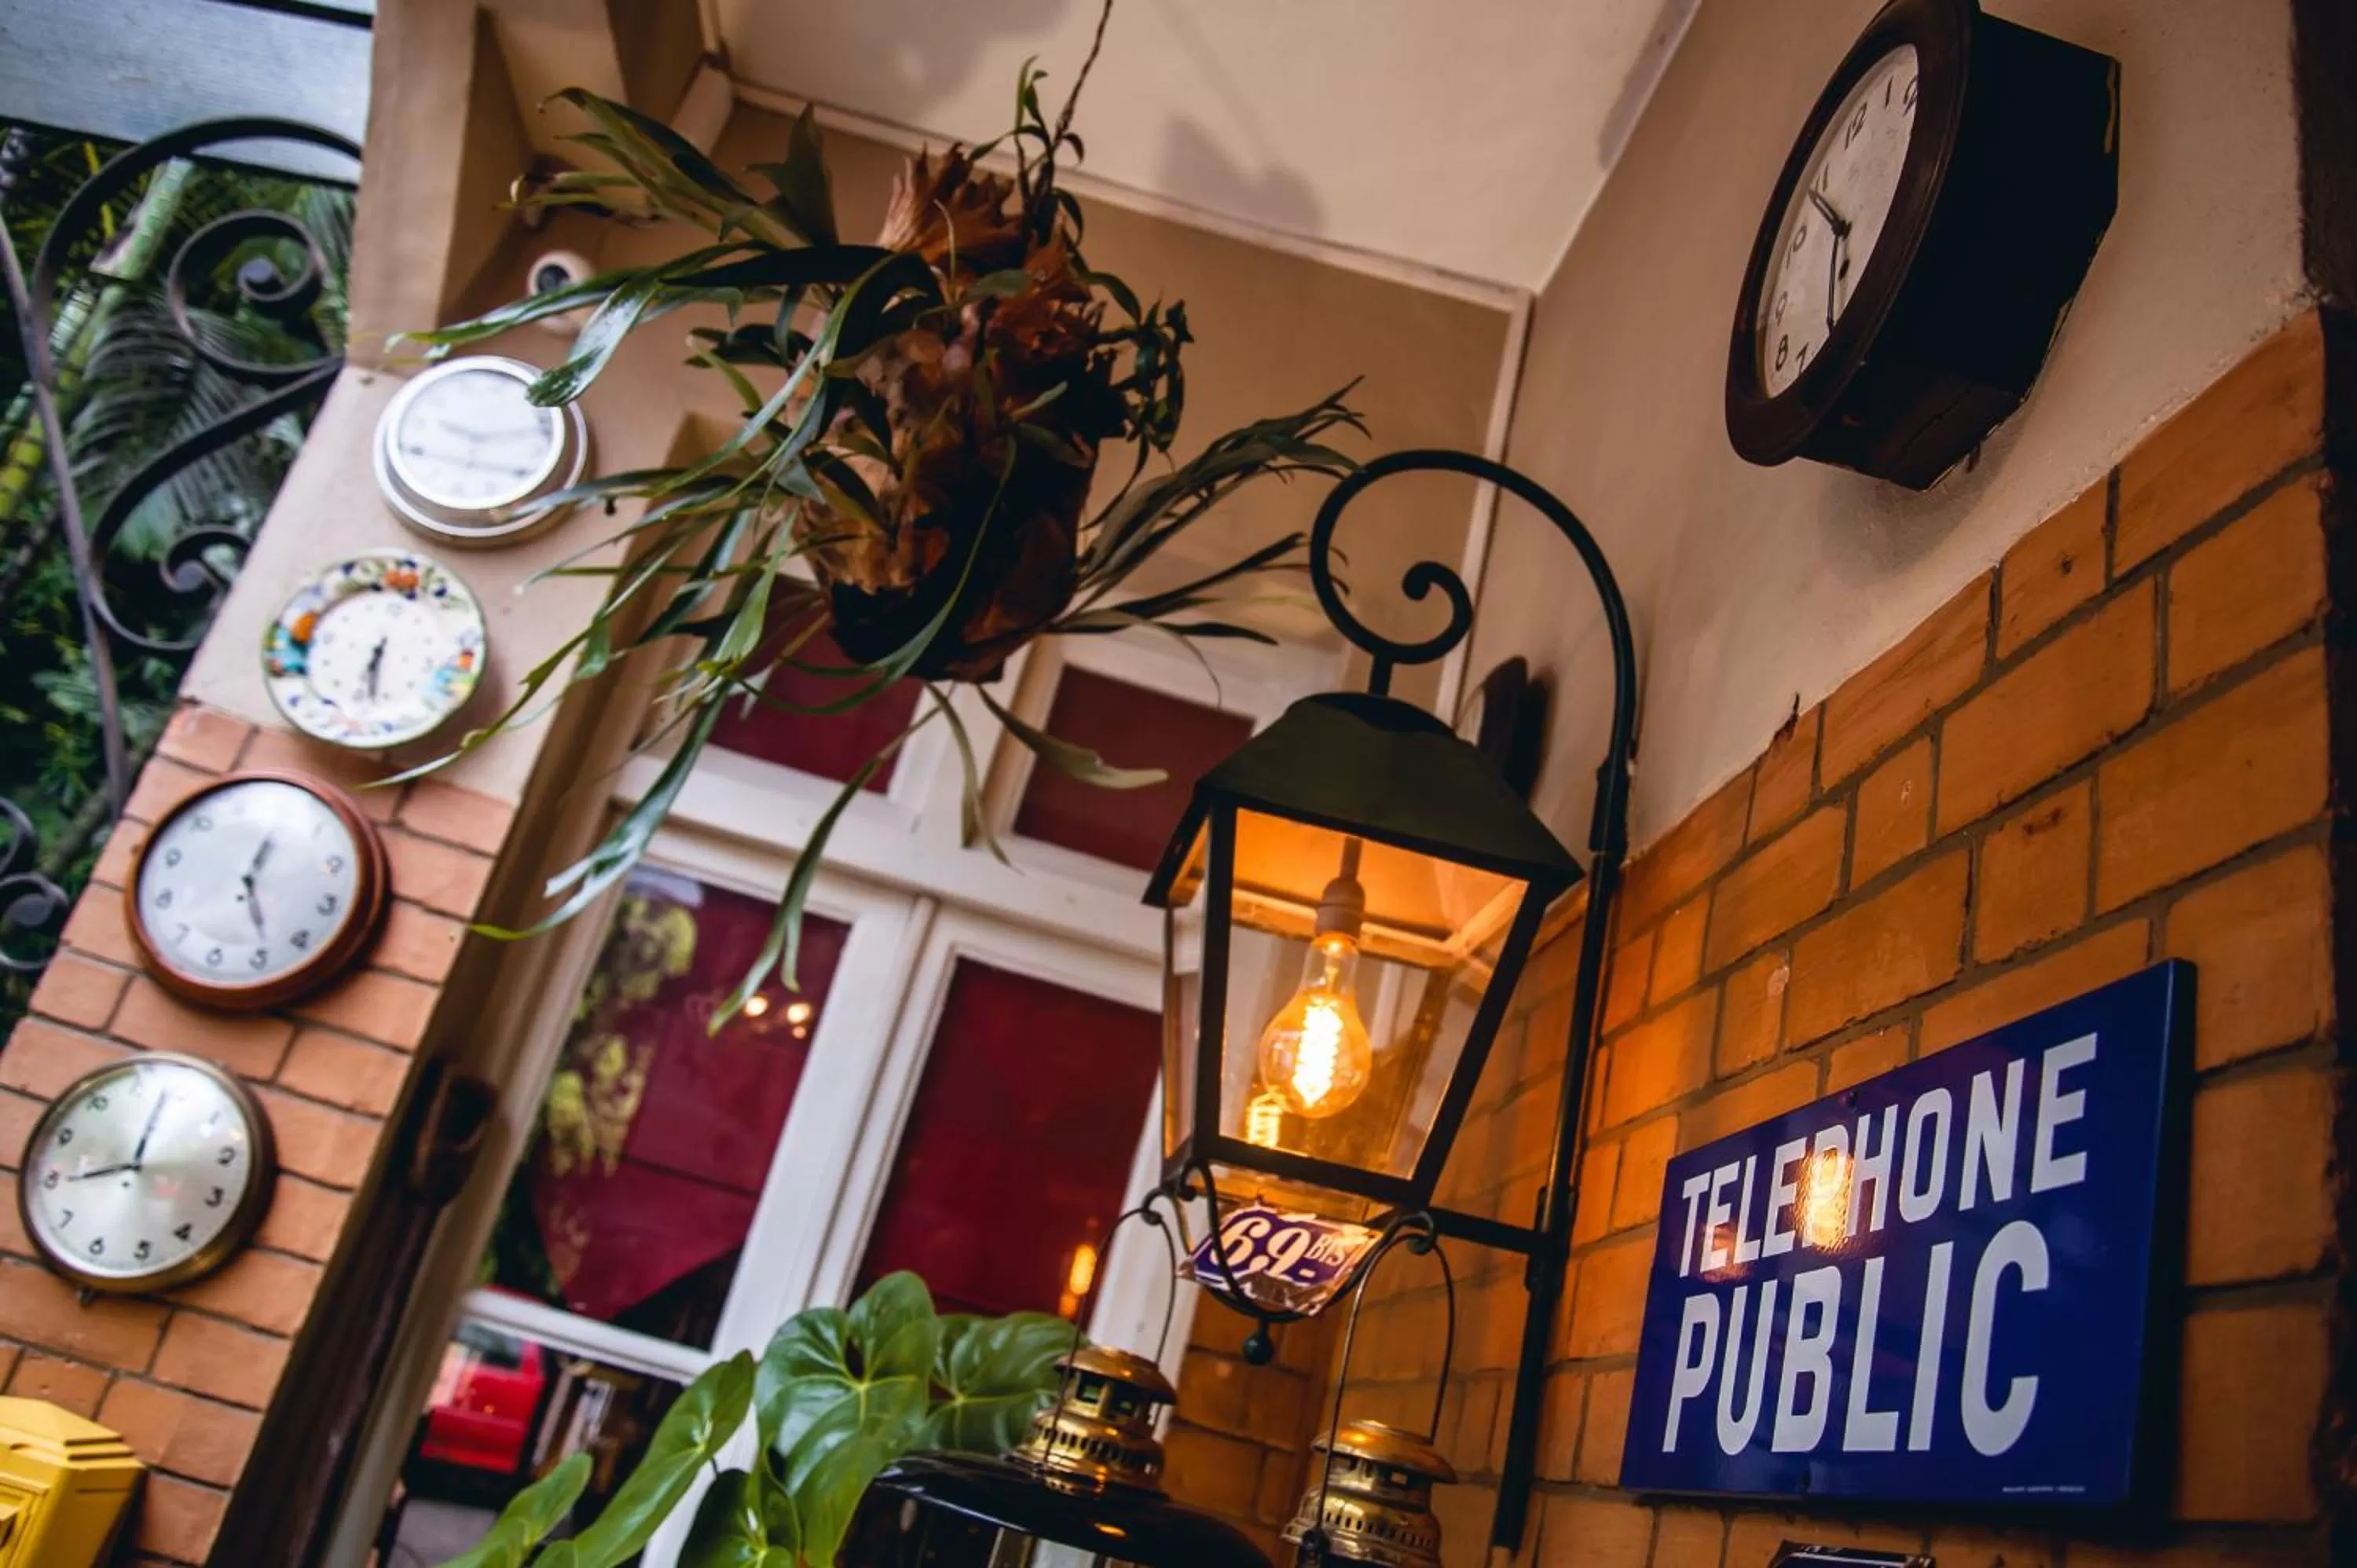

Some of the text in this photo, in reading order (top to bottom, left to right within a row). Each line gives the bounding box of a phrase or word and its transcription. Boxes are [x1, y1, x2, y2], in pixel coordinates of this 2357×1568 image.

[1884, 75, 1894, 109] 1
[1845, 101, 1868, 151] 12
[1776, 334, 1788, 372] 8
[1796, 342, 1809, 375] 7
[316, 893, 338, 916] 3
[206, 947, 224, 967] 6
[247, 947, 268, 970] 5
[1679, 1032, 2098, 1278] TELEPHONE
[204, 1185, 225, 1207] 3
[59, 1209, 74, 1229] 7
[172, 1222, 193, 1241] 4
[88, 1236, 104, 1256] 6
[133, 1240, 152, 1260] 5
[1210, 1217, 1311, 1277] 69
[1662, 1220, 2050, 1457] PUBLIC
